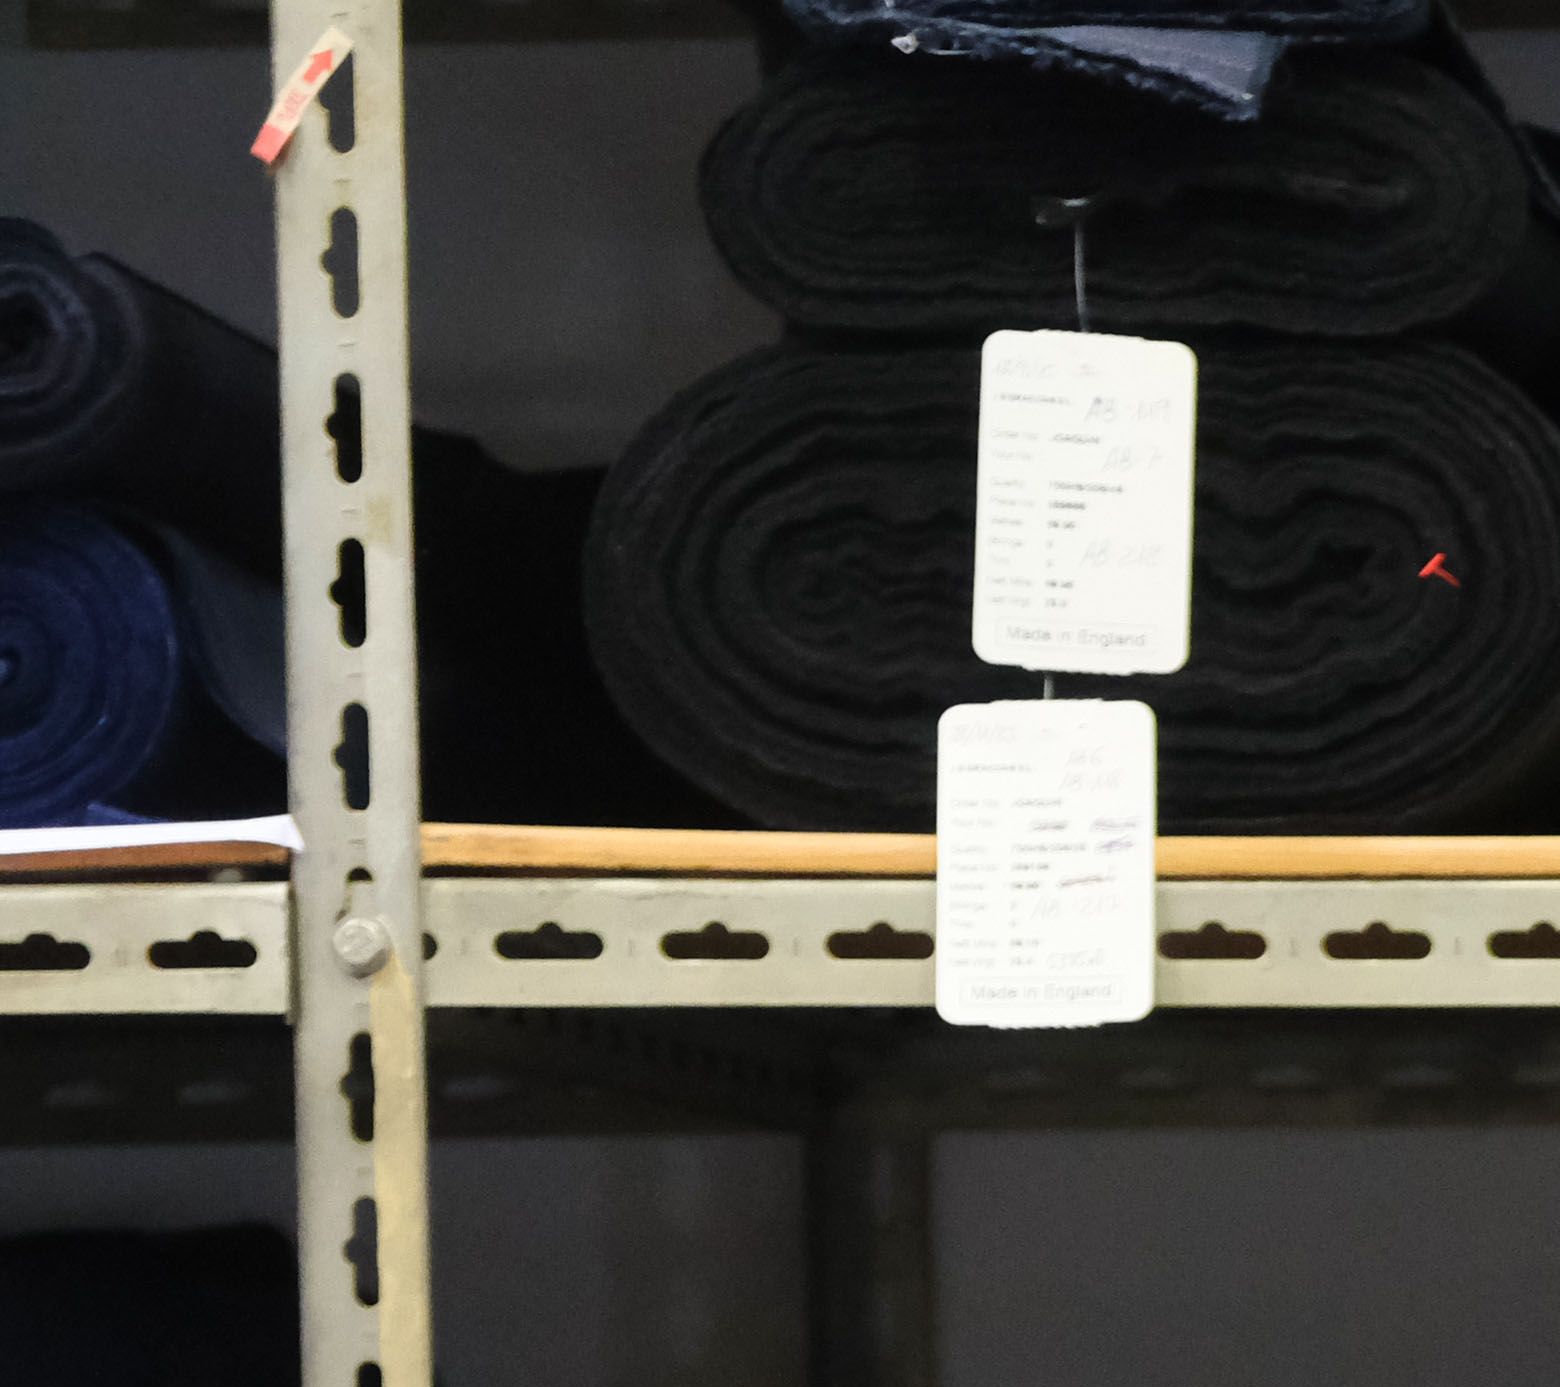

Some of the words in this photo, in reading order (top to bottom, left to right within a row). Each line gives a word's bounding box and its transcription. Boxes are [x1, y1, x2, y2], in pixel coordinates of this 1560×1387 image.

[1006, 626, 1052, 642] Made
[1058, 628, 1072, 643] in
[1077, 629, 1147, 648] England
[970, 984, 1018, 1000] Made
[1022, 983, 1038, 1000] in
[1044, 982, 1112, 1002] England
